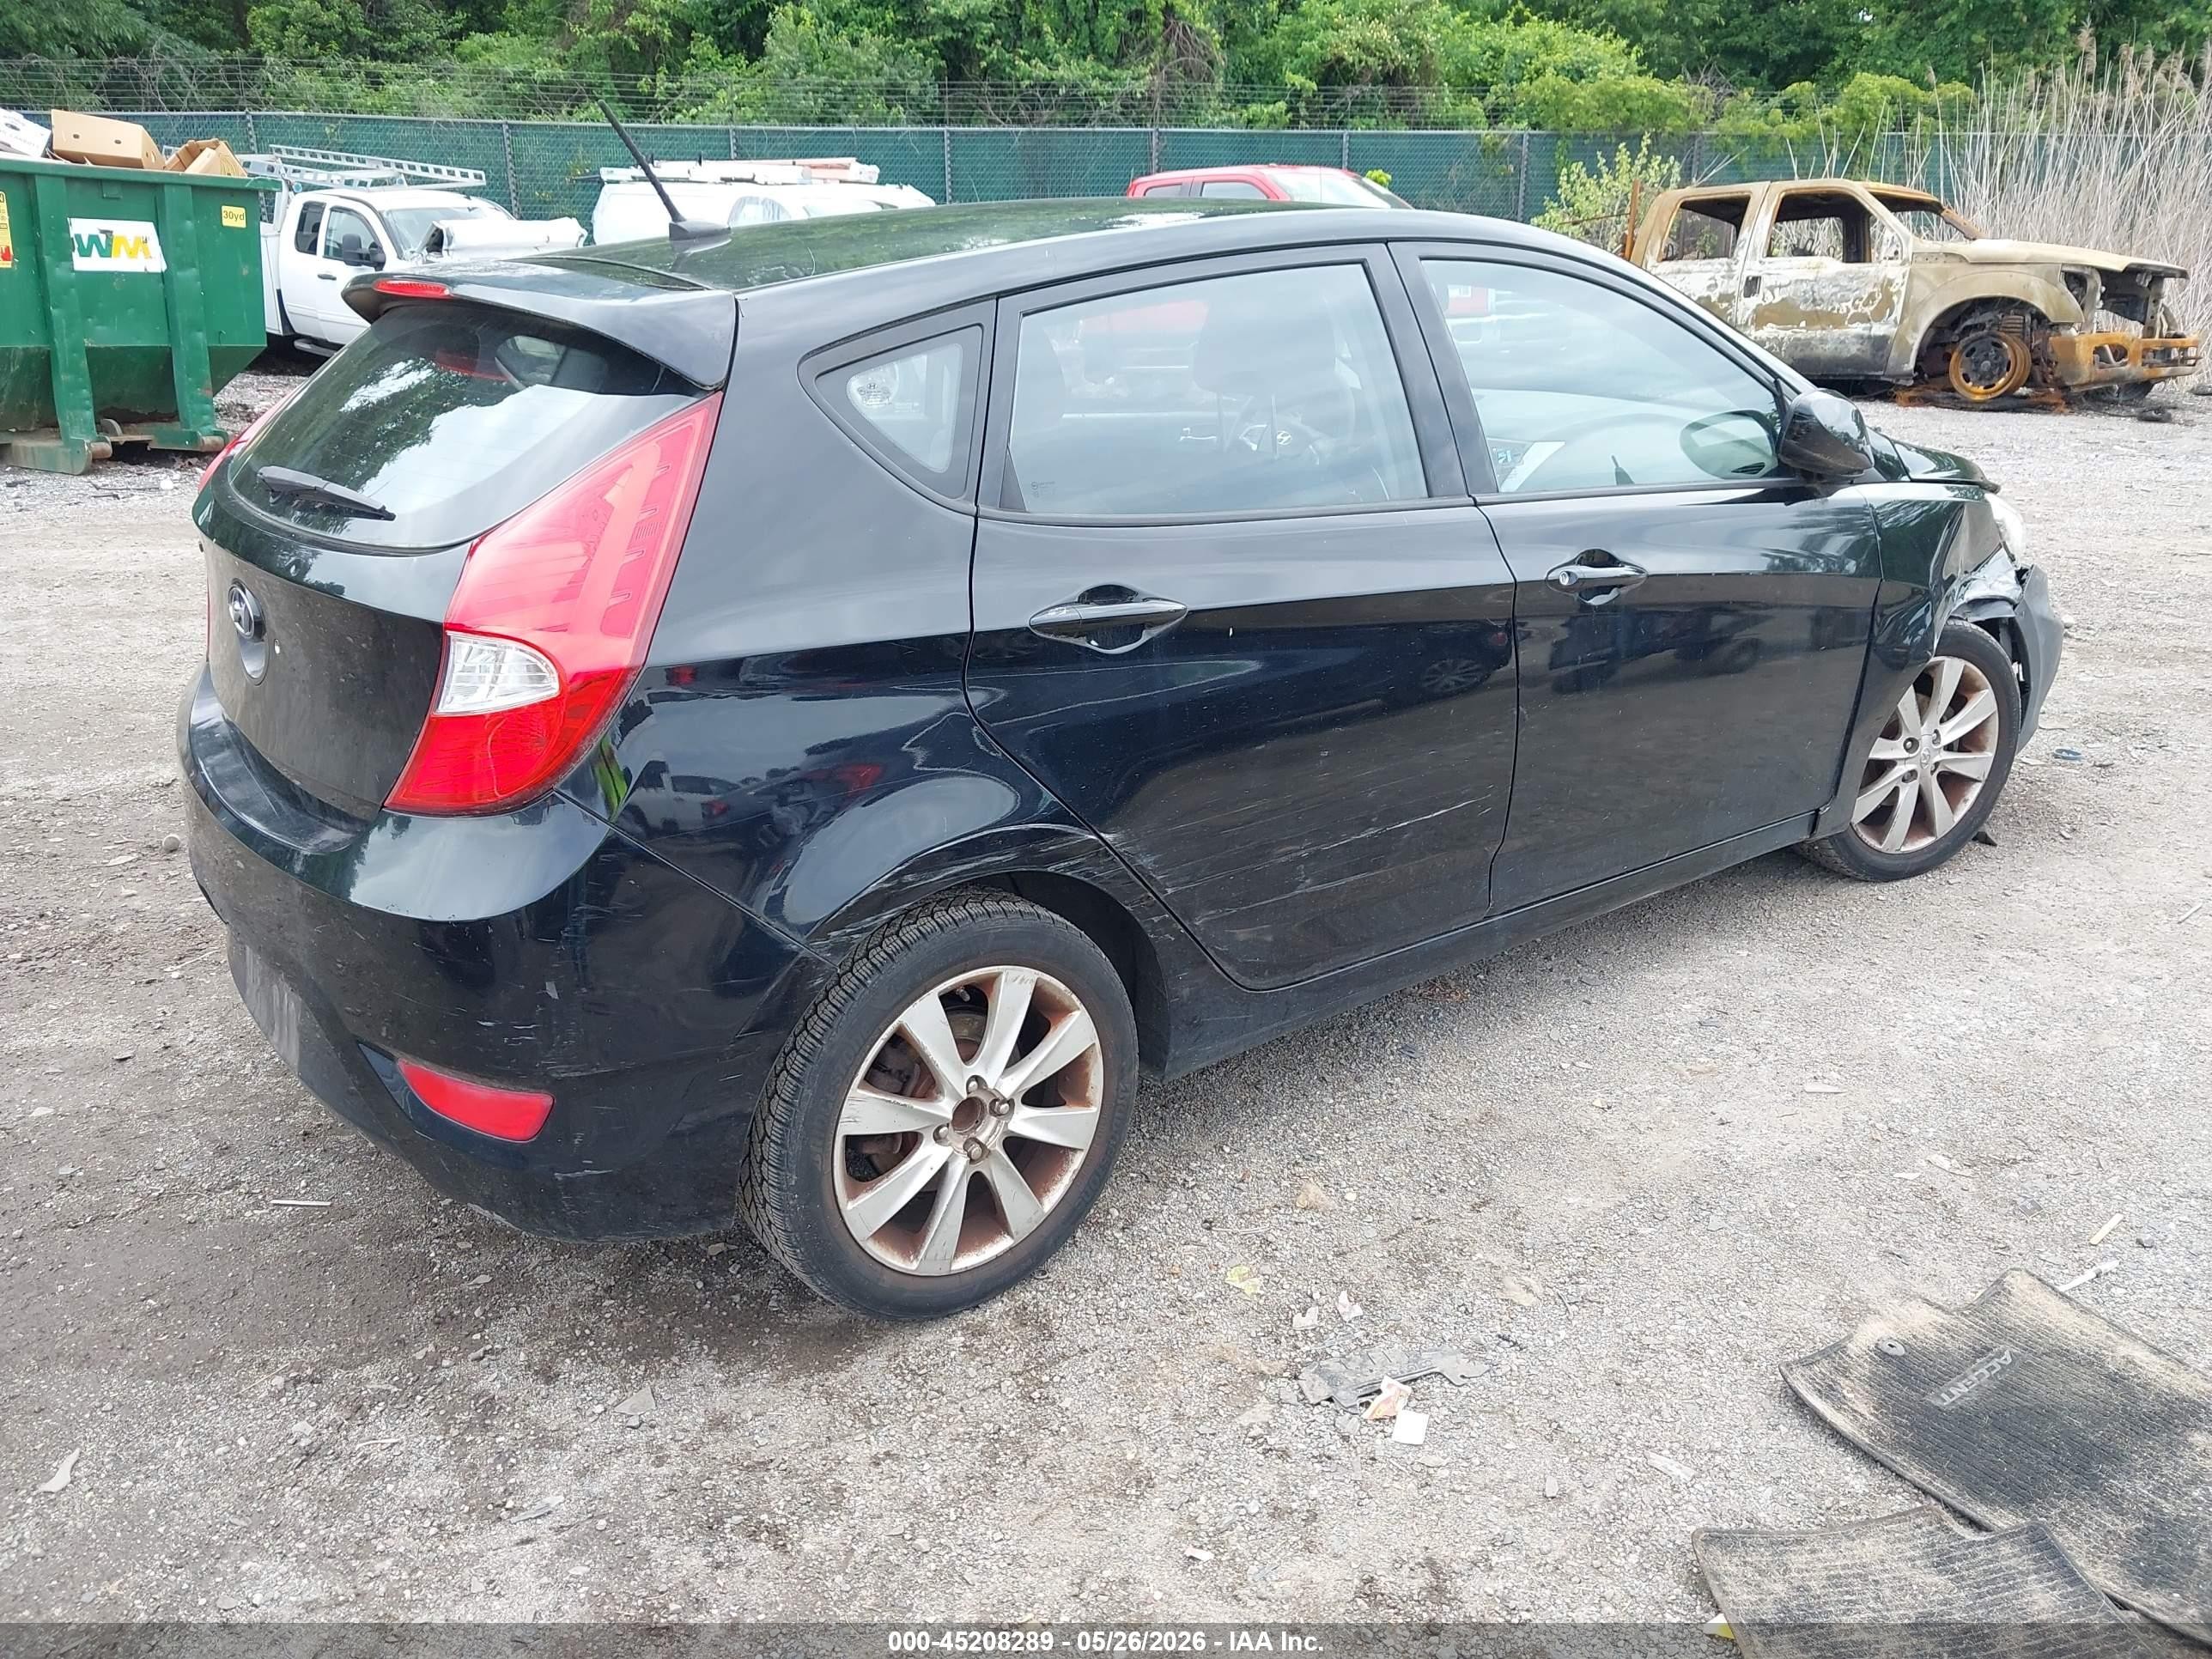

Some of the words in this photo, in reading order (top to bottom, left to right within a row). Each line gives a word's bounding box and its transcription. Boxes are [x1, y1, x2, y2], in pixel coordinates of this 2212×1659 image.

[222, 210, 246, 223] 30yd
[74, 234, 153, 259] WM
[1941, 1349, 2013, 1406] ACCENT
